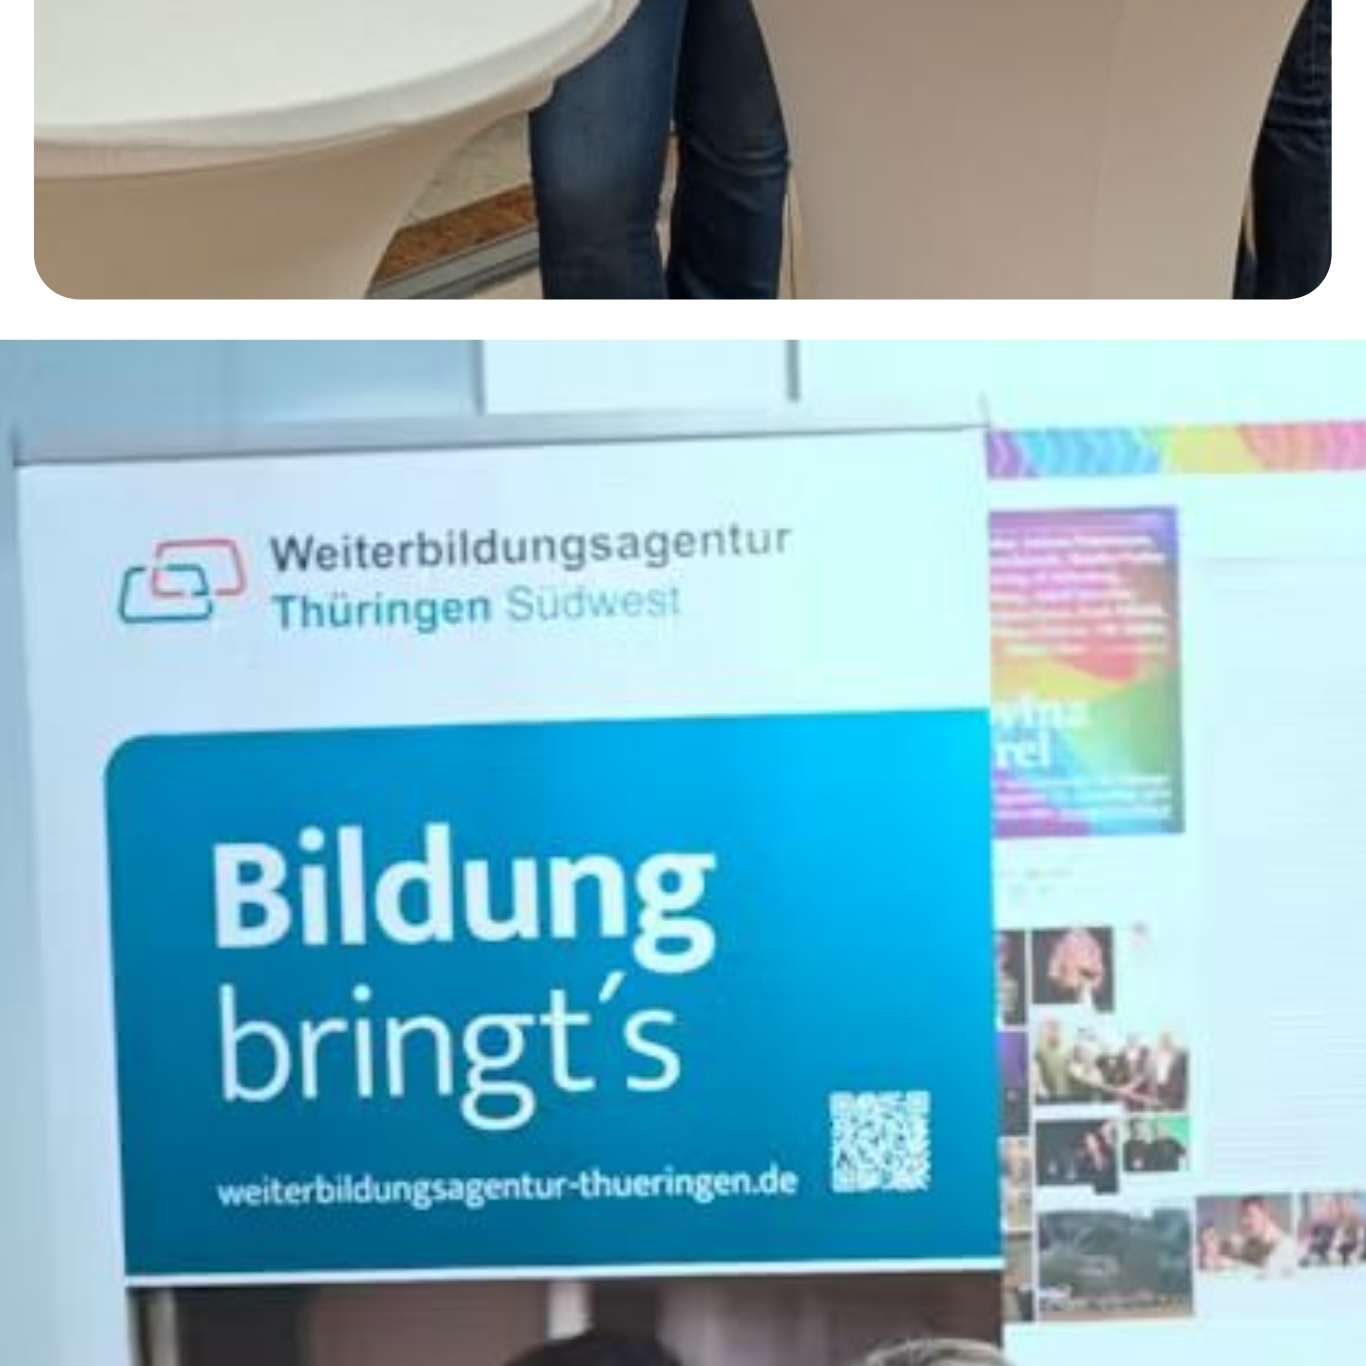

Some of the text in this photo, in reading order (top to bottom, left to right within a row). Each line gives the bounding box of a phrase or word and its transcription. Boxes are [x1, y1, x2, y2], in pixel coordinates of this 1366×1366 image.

[270, 523, 794, 573] Weiterbildungsagentur
[271, 582, 682, 634] Thüringen Südwest
[210, 820, 717, 974] Bildung
[217, 1163, 799, 1211] weiterbildungsagentur-thueringen.de
